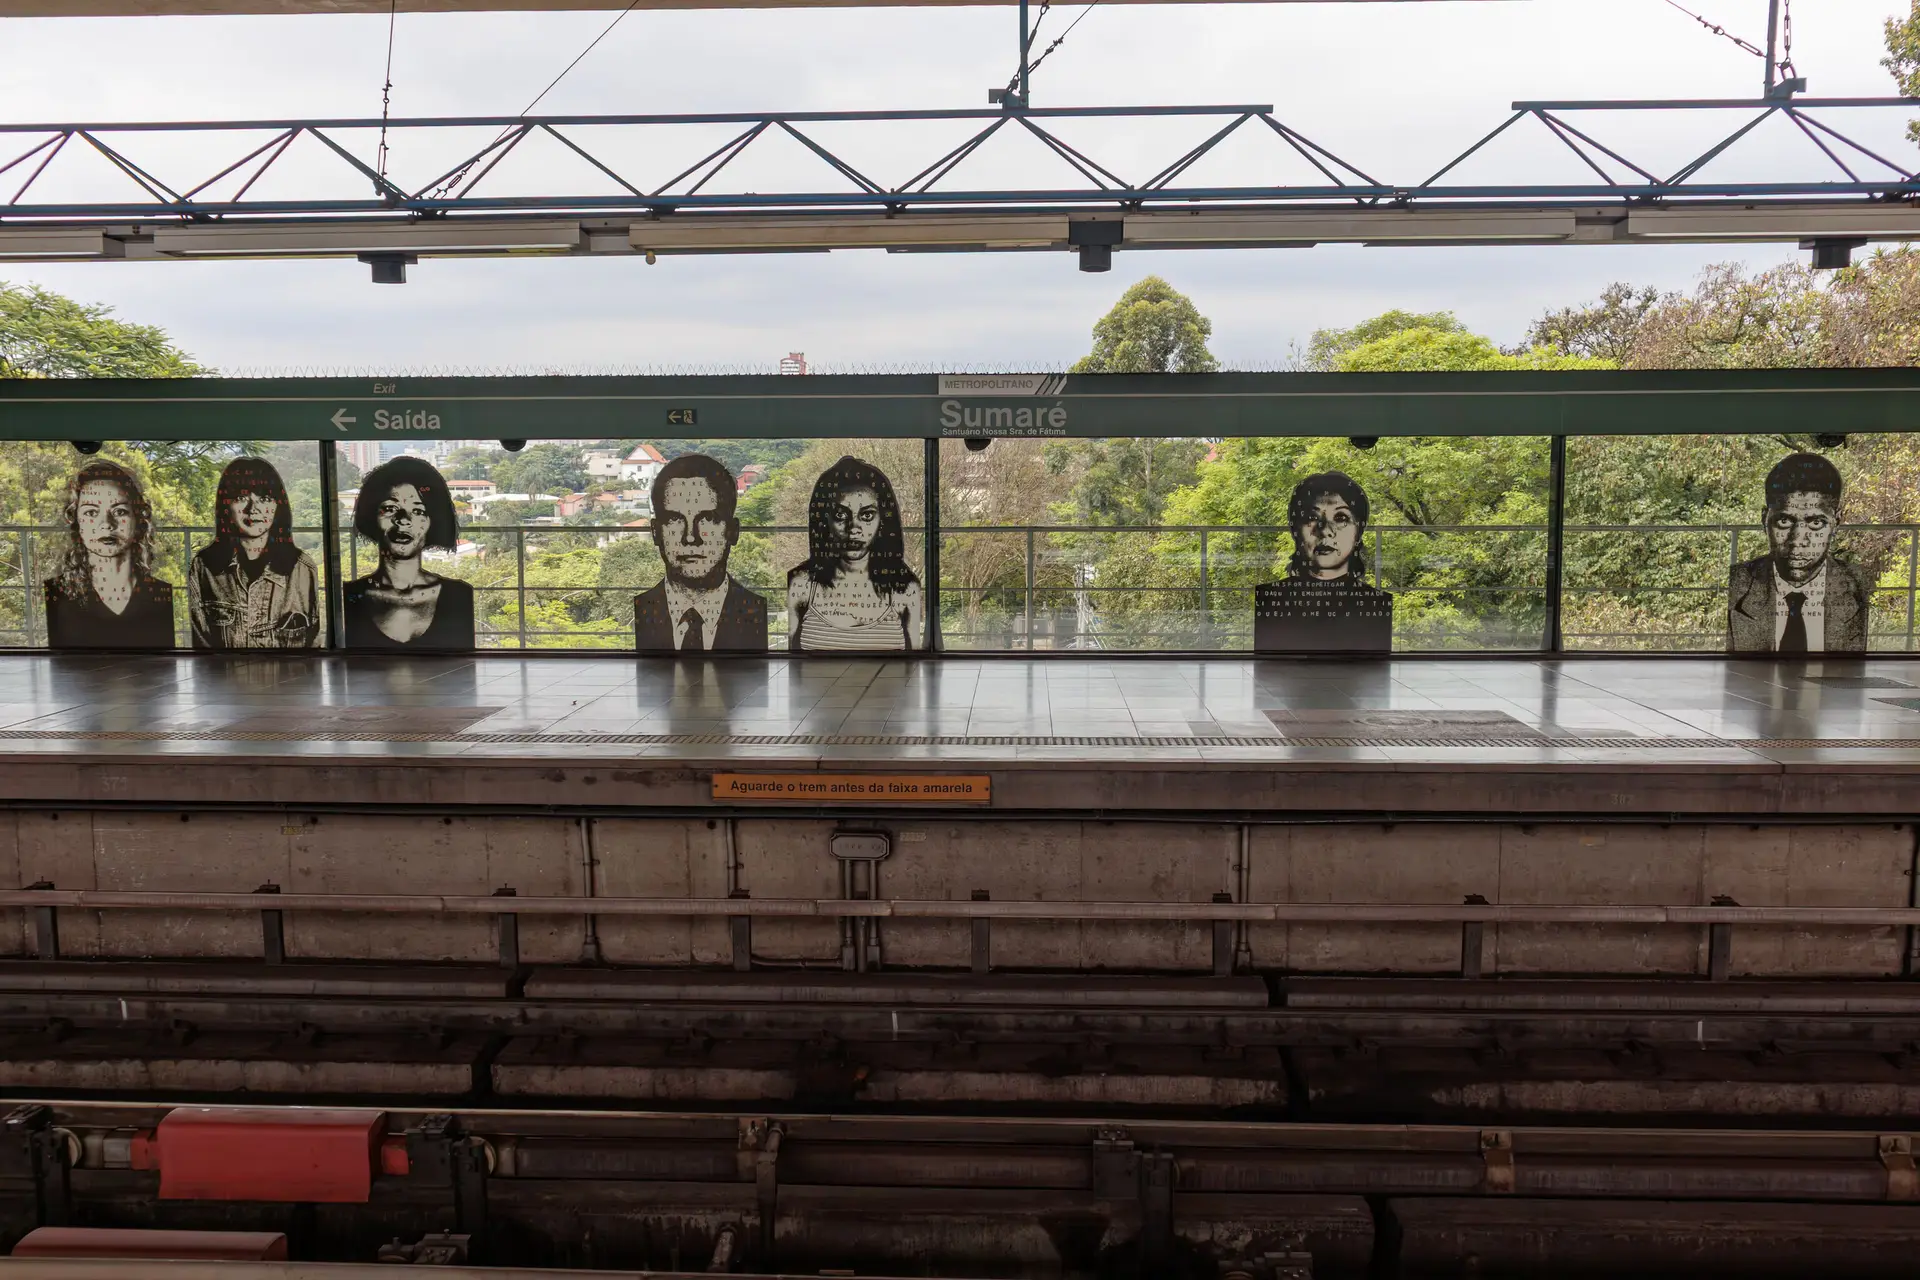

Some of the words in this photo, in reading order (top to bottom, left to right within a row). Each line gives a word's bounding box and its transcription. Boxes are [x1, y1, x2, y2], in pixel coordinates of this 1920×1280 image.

[373, 383, 396, 394] Exit
[944, 379, 1034, 389] METROPOLITANO
[373, 409, 441, 430] Saída
[939, 400, 1068, 428] Sumaré
[942, 427, 981, 436] Santuário
[982, 428, 1008, 436] Nossa
[1009, 428, 1025, 436] Sra.
[1027, 428, 1037, 436] de
[1039, 427, 1066, 436] Fátima
[730, 780, 783, 793] Aguarde
[787, 783, 795, 792] o
[798, 781, 827, 792] trem
[830, 782, 865, 793] antes
[868, 781, 884, 793] da
[888, 782, 918, 793] faixa
[923, 782, 972, 794] amarela
